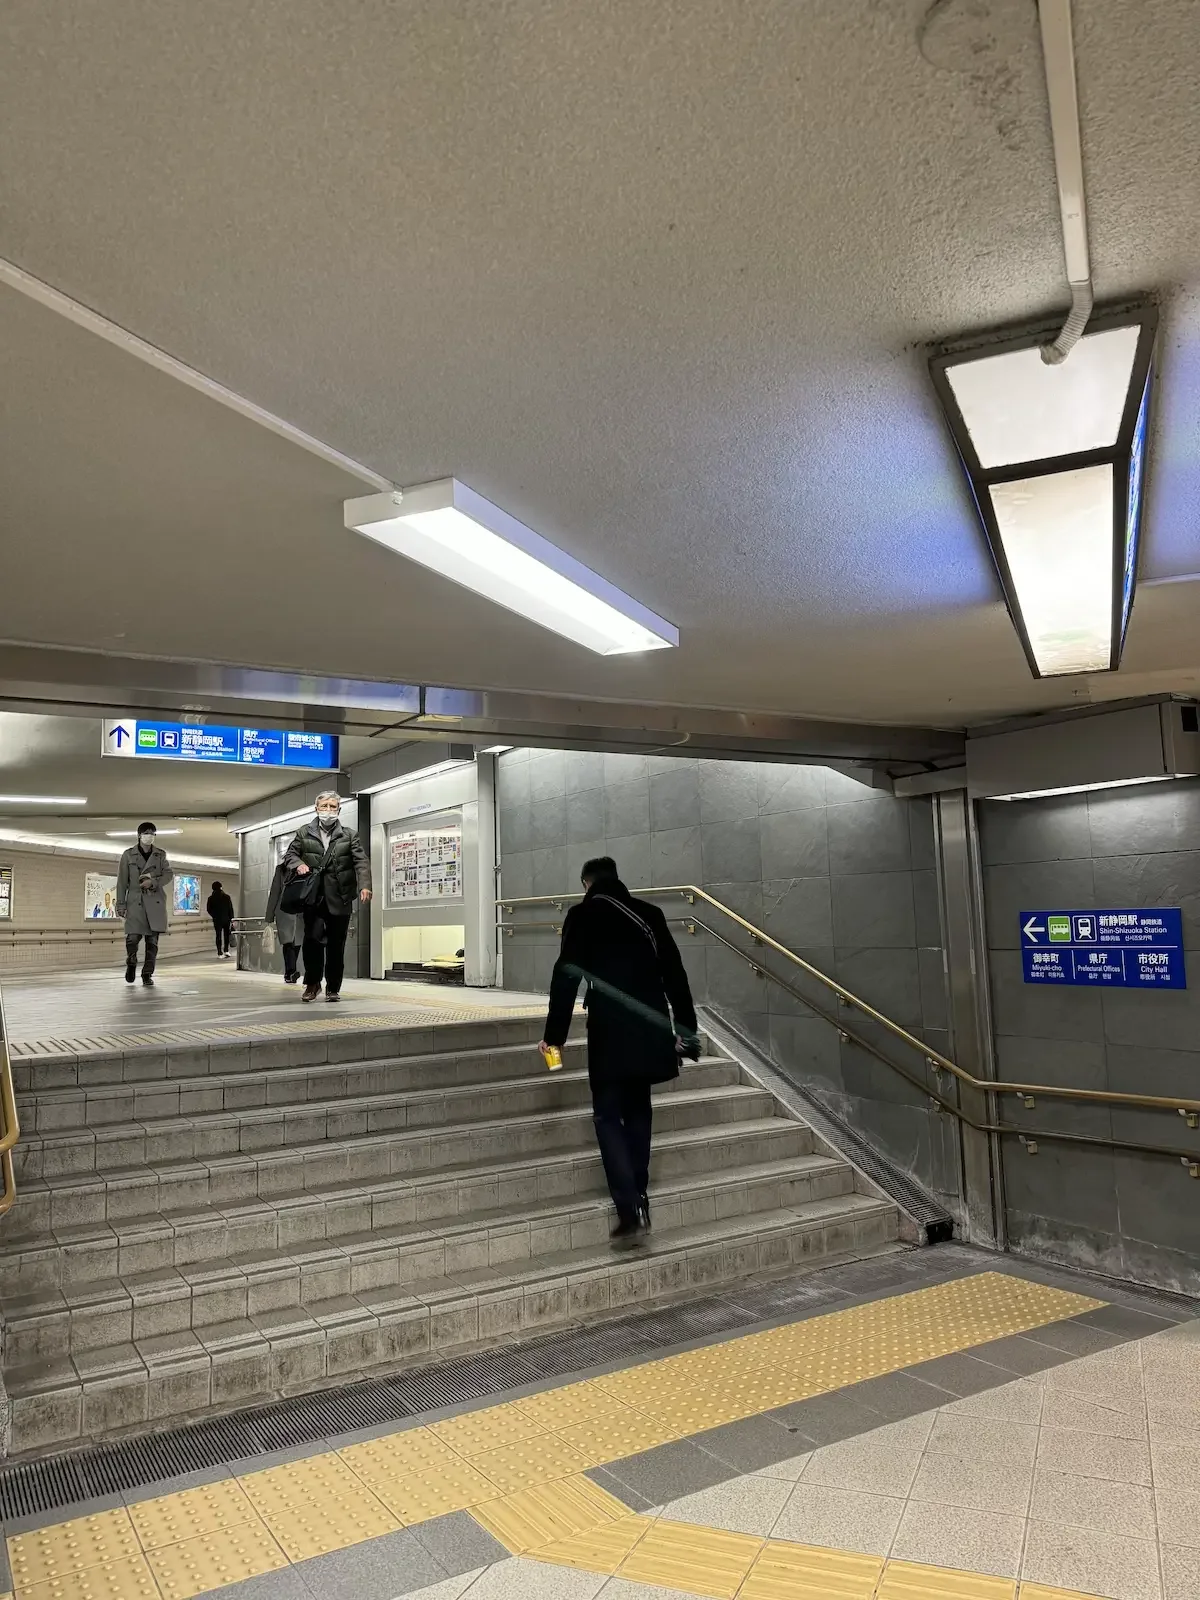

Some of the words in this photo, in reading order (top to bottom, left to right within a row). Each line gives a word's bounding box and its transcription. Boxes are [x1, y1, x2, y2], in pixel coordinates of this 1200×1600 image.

[182, 735, 224, 746] 新静岡駅
[1099, 915, 1138, 926] 新静岡駅
[1033, 953, 1059, 964] 御幸町
[1089, 953, 1108, 964] 県庁
[1138, 953, 1168, 964] 市役所
